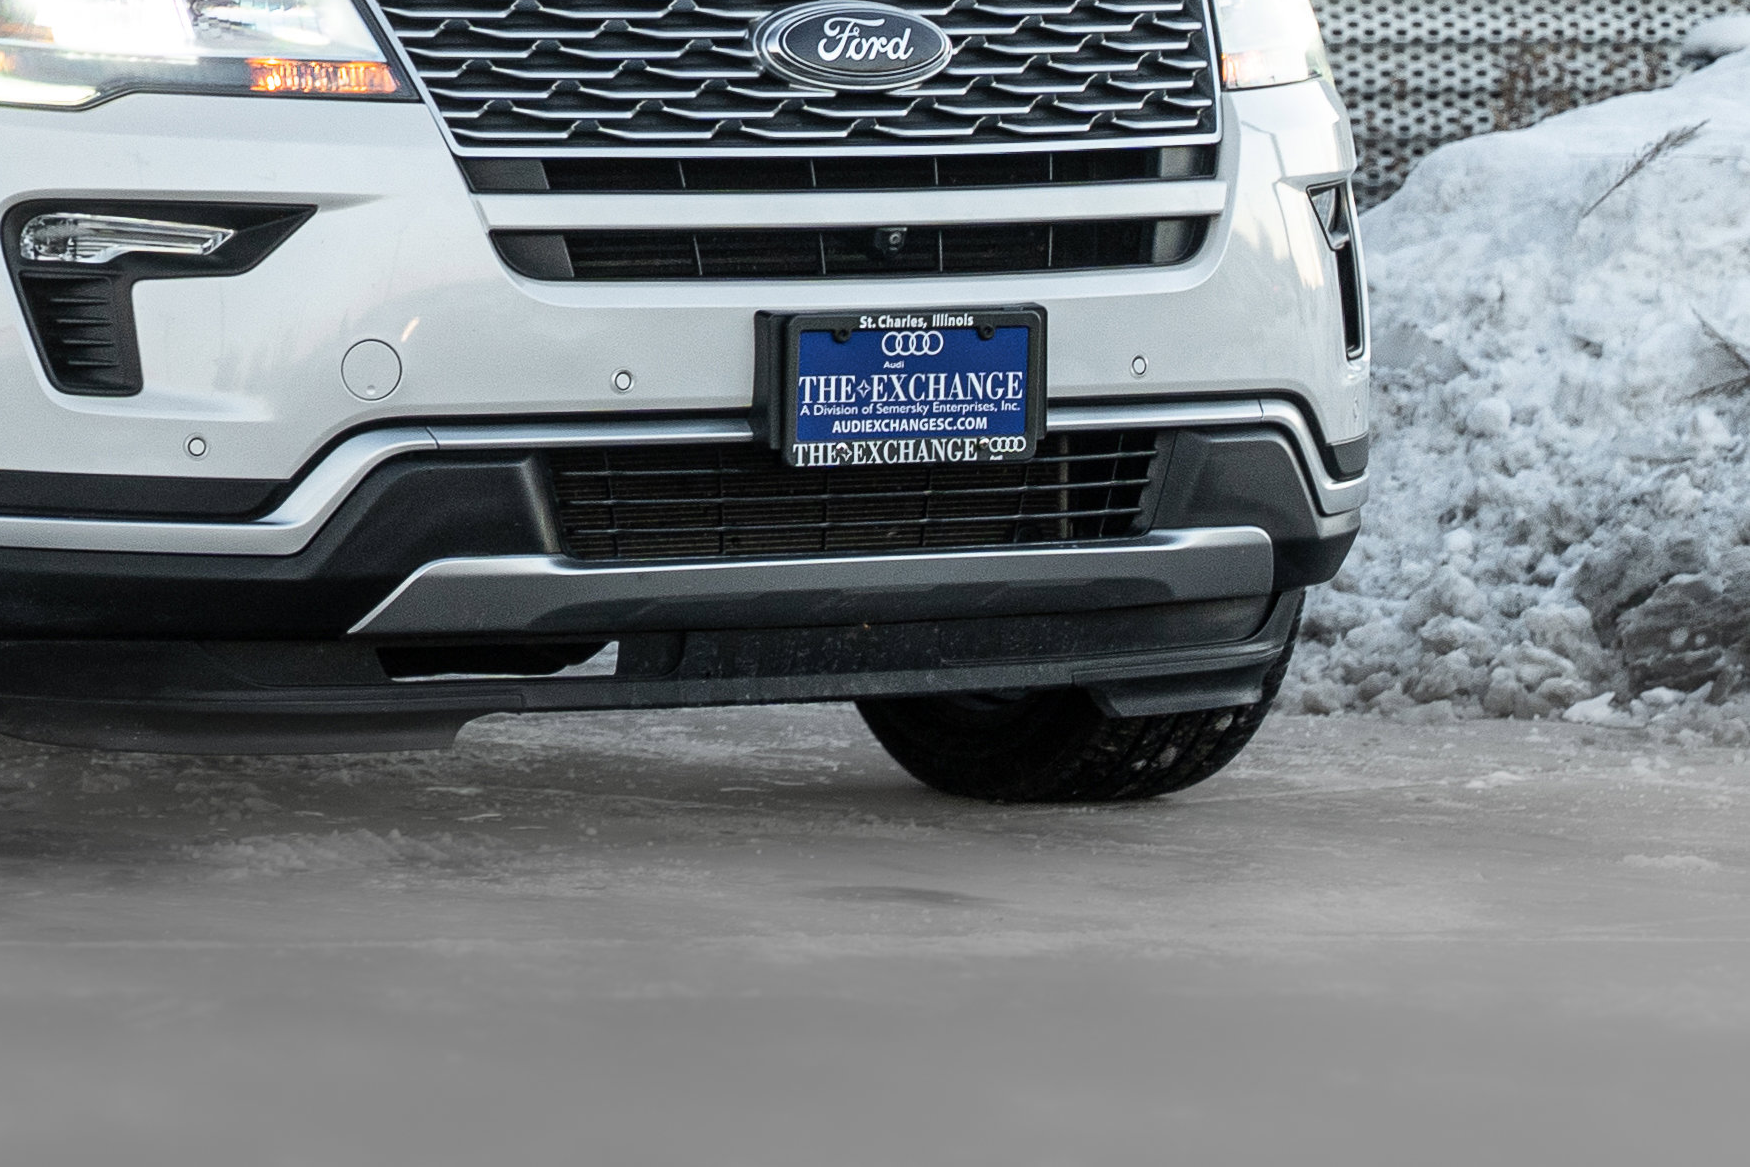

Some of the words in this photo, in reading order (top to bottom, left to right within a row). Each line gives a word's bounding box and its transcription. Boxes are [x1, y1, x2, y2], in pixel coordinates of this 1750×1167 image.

[817, 17, 914, 62] Ford
[859, 315, 876, 329] St.
[878, 314, 927, 329] Charles,
[932, 313, 974, 327] Illinois
[883, 360, 905, 369] Audi
[798, 375, 856, 404] THE
[870, 371, 1023, 402] EXCHANGE
[800, 405, 810, 416] A
[813, 404, 858, 416] Division
[862, 403, 874, 414] of
[876, 401, 929, 416] Semersky
[932, 401, 998, 414] Enterprises,
[1001, 400, 1020, 411] Inc.
[832, 417, 988, 433] AUDIEXCHANGESC.COM
[793, 442, 841, 467] THE
[852, 438, 978, 465] EXCHANGE
